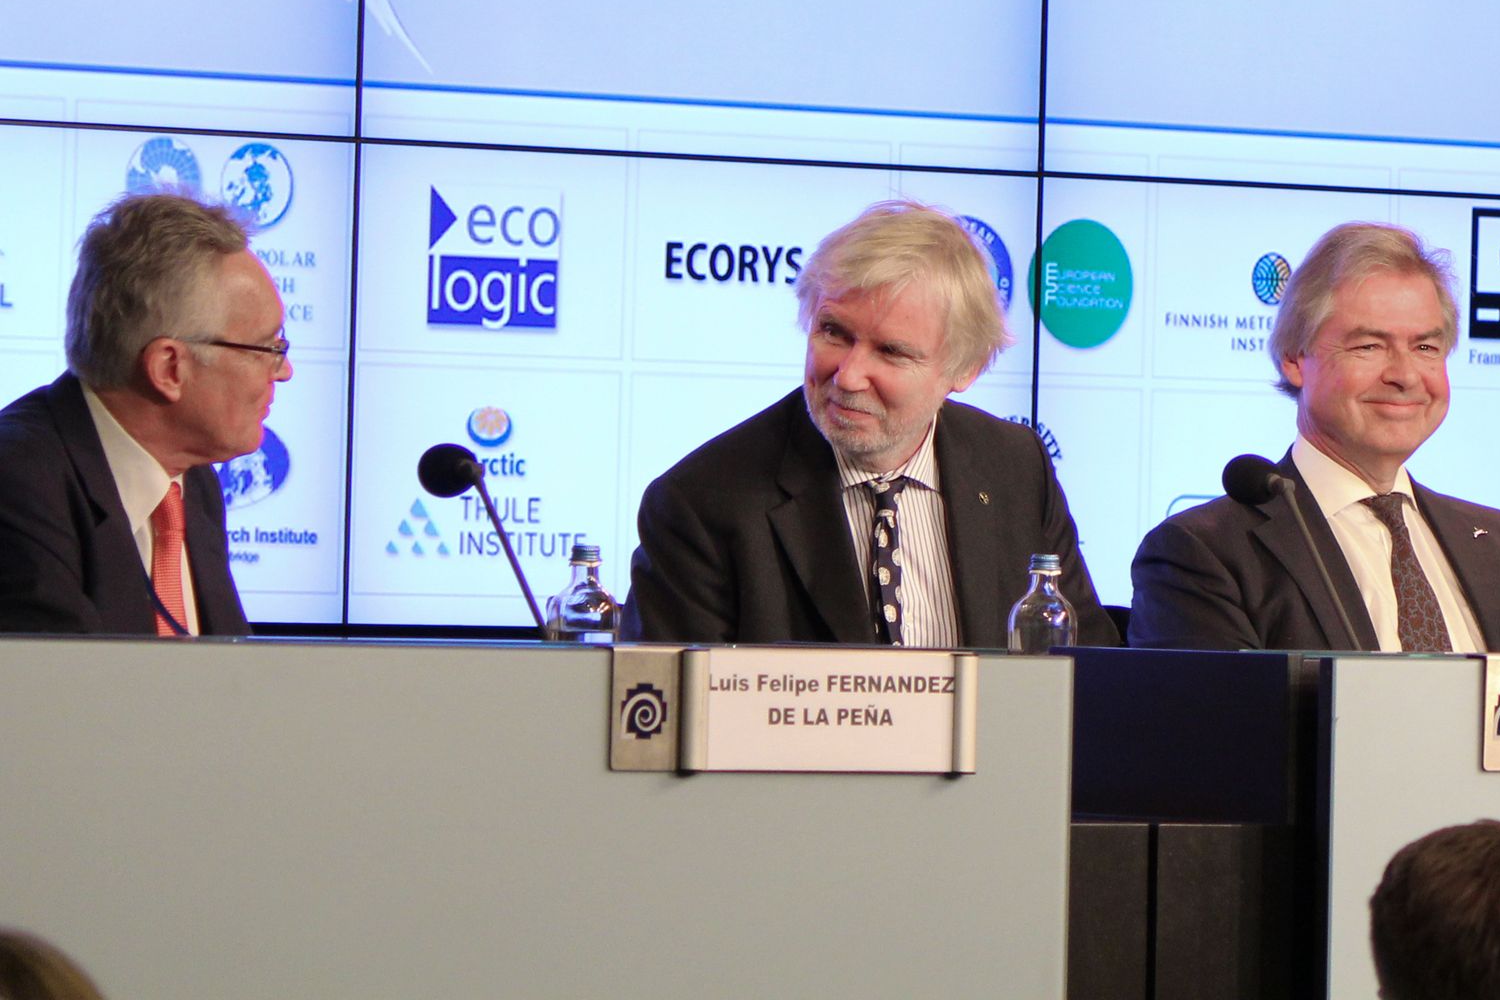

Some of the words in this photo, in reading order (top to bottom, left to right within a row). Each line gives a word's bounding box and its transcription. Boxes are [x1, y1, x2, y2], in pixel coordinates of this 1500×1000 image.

[466, 204, 561, 248] eco
[665, 241, 802, 285] ECORYS
[430, 254, 556, 329] logic
[1165, 312, 1228, 329] FINNISH
[481, 452, 526, 476] rctic
[460, 496, 541, 523] THULE
[254, 526, 318, 544] Institute
[708, 674, 750, 692] Luis
[756, 674, 820, 697] Felipe
[826, 674, 956, 695] FERNANDEZ
[767, 707, 796, 726] DE
[802, 707, 830, 726] LA
[836, 704, 894, 727] PEÑA
